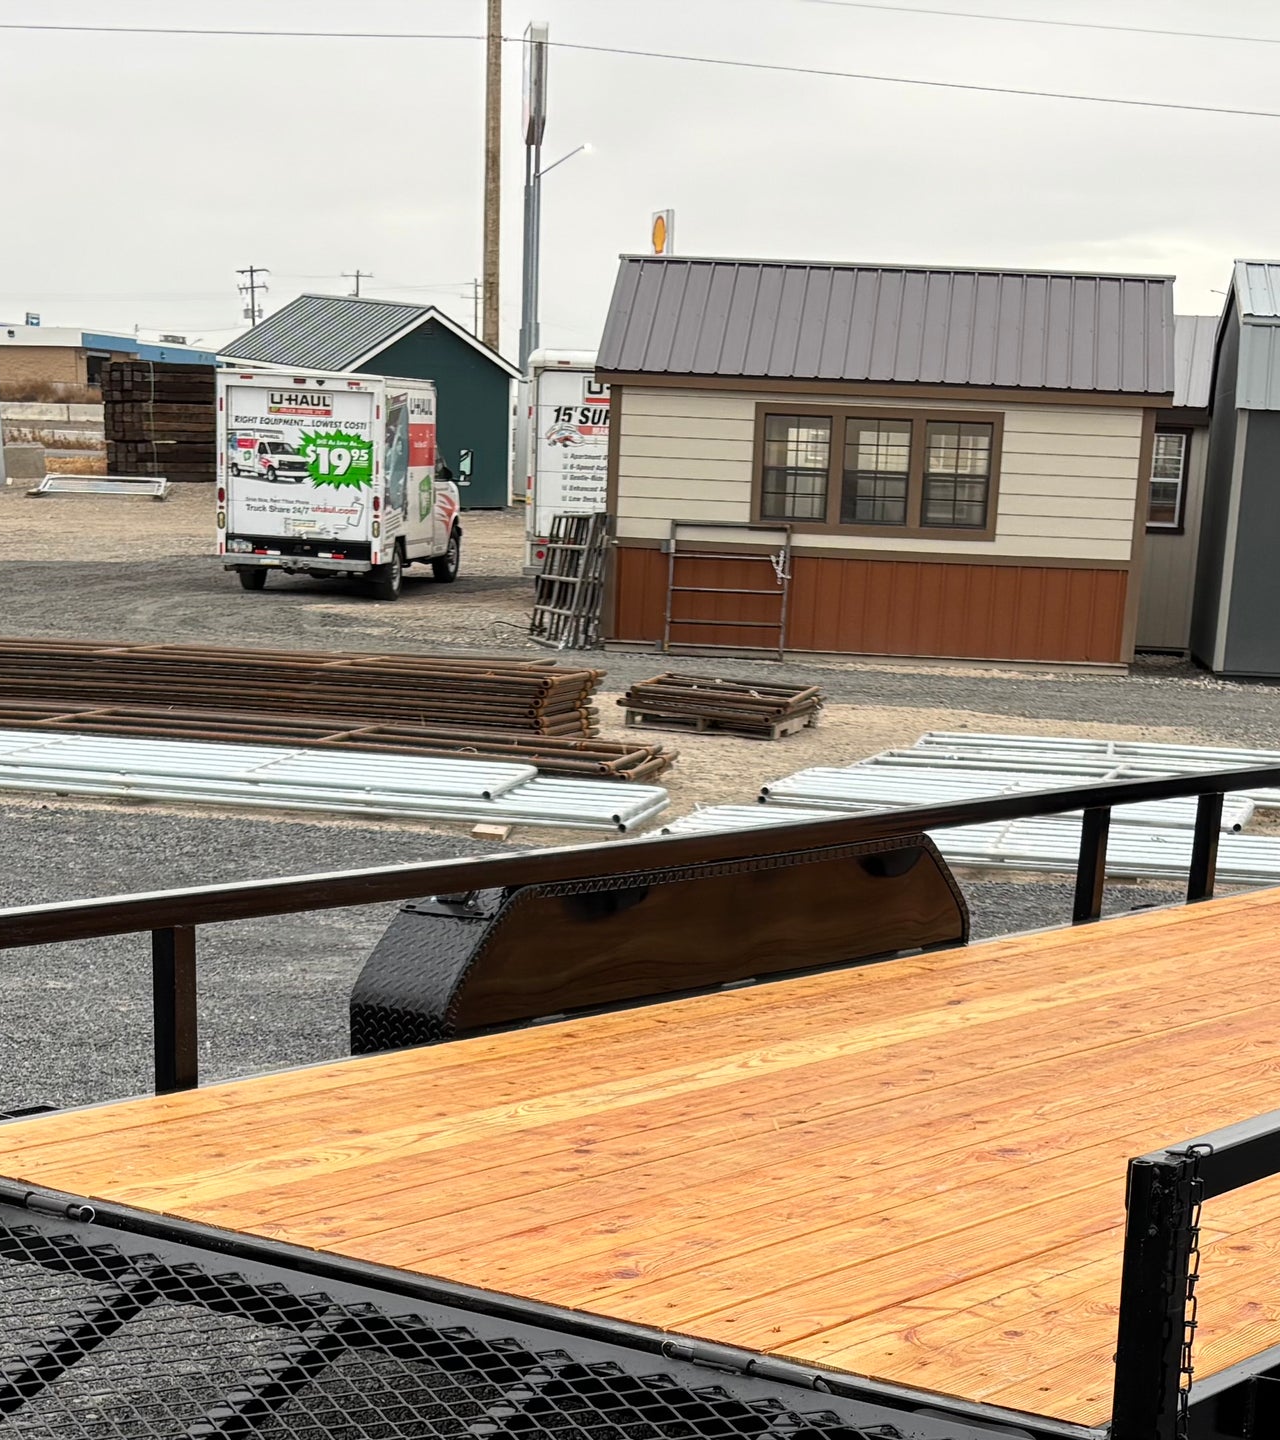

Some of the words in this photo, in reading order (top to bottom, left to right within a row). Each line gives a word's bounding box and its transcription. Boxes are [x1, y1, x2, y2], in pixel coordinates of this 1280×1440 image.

[270, 393, 331, 407] U-HAUL
[234, 415, 258, 425] RIGHT
[344, 421, 367, 430] COST!
[245, 503, 267, 512] Truck
[269, 504, 291, 514] Share
[292, 506, 310, 516] 24/7
